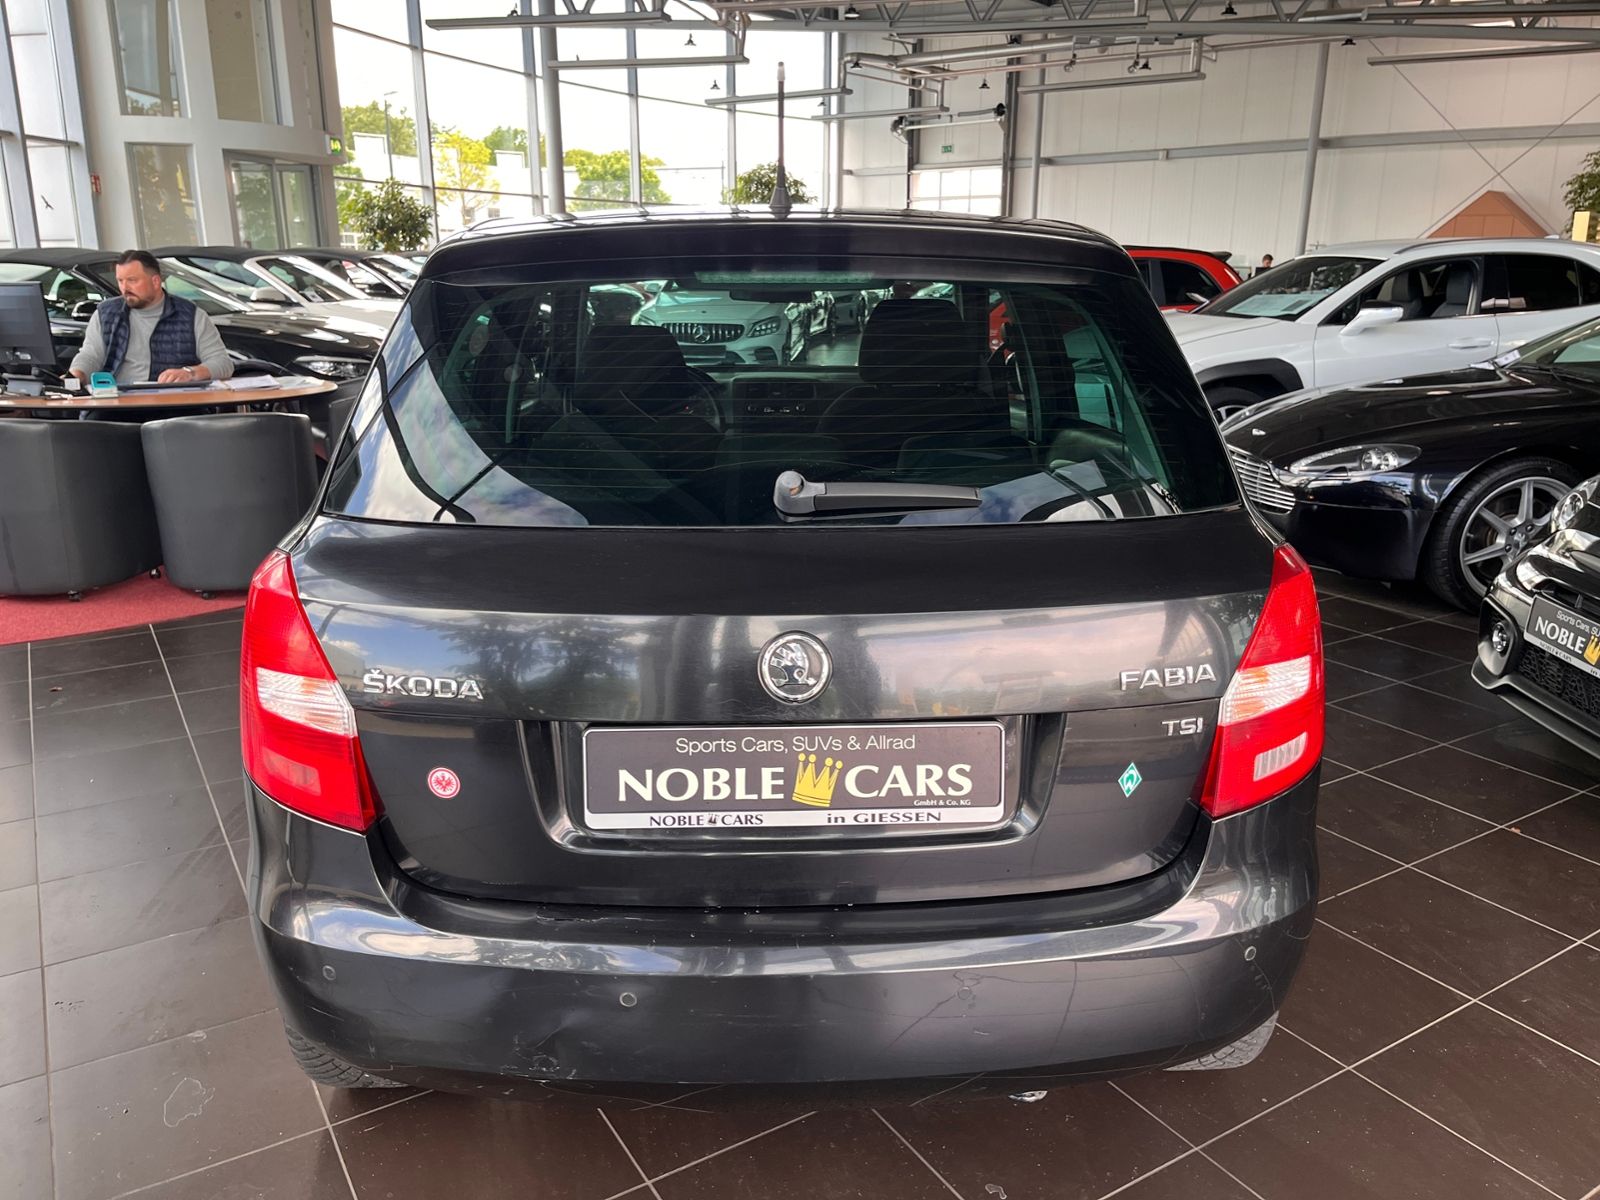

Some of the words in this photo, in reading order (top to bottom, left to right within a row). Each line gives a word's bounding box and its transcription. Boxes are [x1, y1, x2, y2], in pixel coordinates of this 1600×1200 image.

[1535, 616, 1586, 654] NOBLE
[363, 669, 484, 700] ŠKODA
[1120, 663, 1217, 691] FABIA
[1162, 717, 1204, 737] TSI
[676, 737, 737, 756] Sports
[741, 737, 788, 753] Cars,
[792, 736, 843, 751] SUVs
[847, 735, 861, 750] &
[865, 735, 916, 750] Allrad
[618, 767, 785, 801] NOBLE
[844, 764, 973, 798] CARS
[650, 815, 704, 826] NOBLE
[721, 814, 763, 826] CARS
[827, 813, 845, 824] in
[853, 812, 941, 824] GIESSEN
